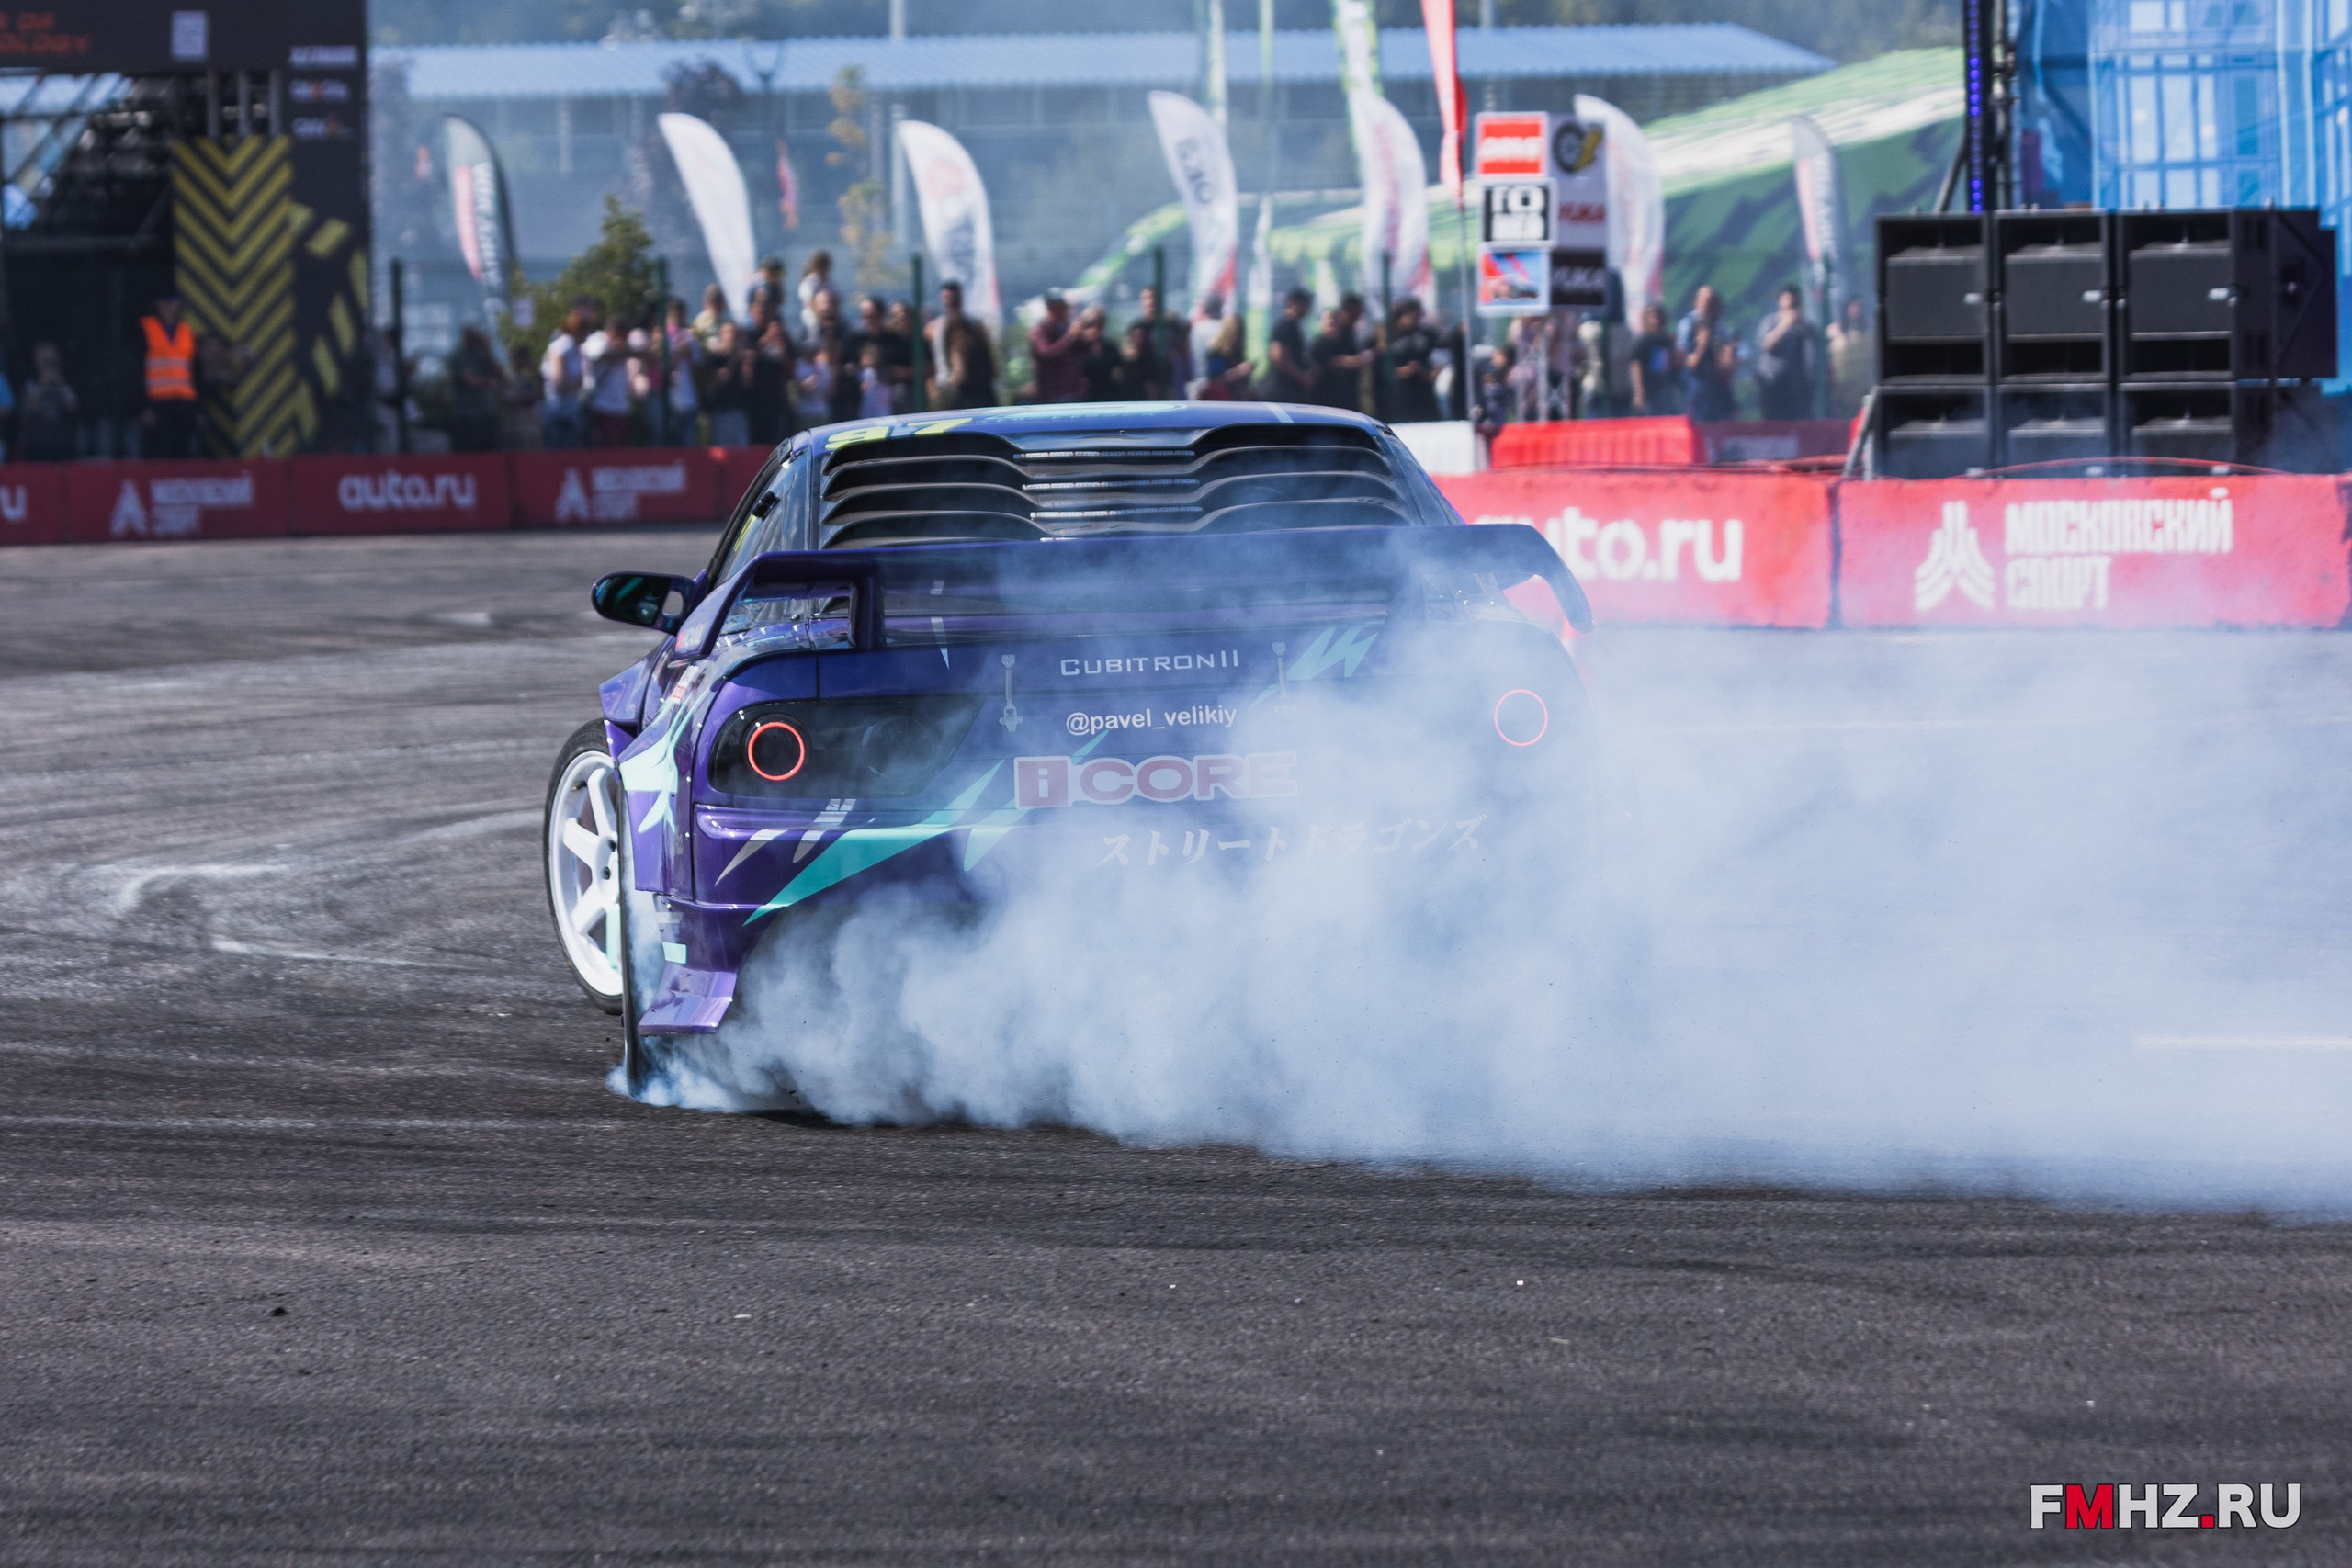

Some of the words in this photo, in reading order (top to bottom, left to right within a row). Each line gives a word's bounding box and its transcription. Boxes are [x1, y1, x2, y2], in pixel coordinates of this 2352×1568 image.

[338, 469, 476, 510] auto.ru
[1474, 507, 1743, 582] to.ru
[2005, 487, 2234, 554] МОСКОВСКИЙ
[2005, 555, 2111, 610] СПОРТ
[1066, 705, 1237, 736] @pavel_velikiy
